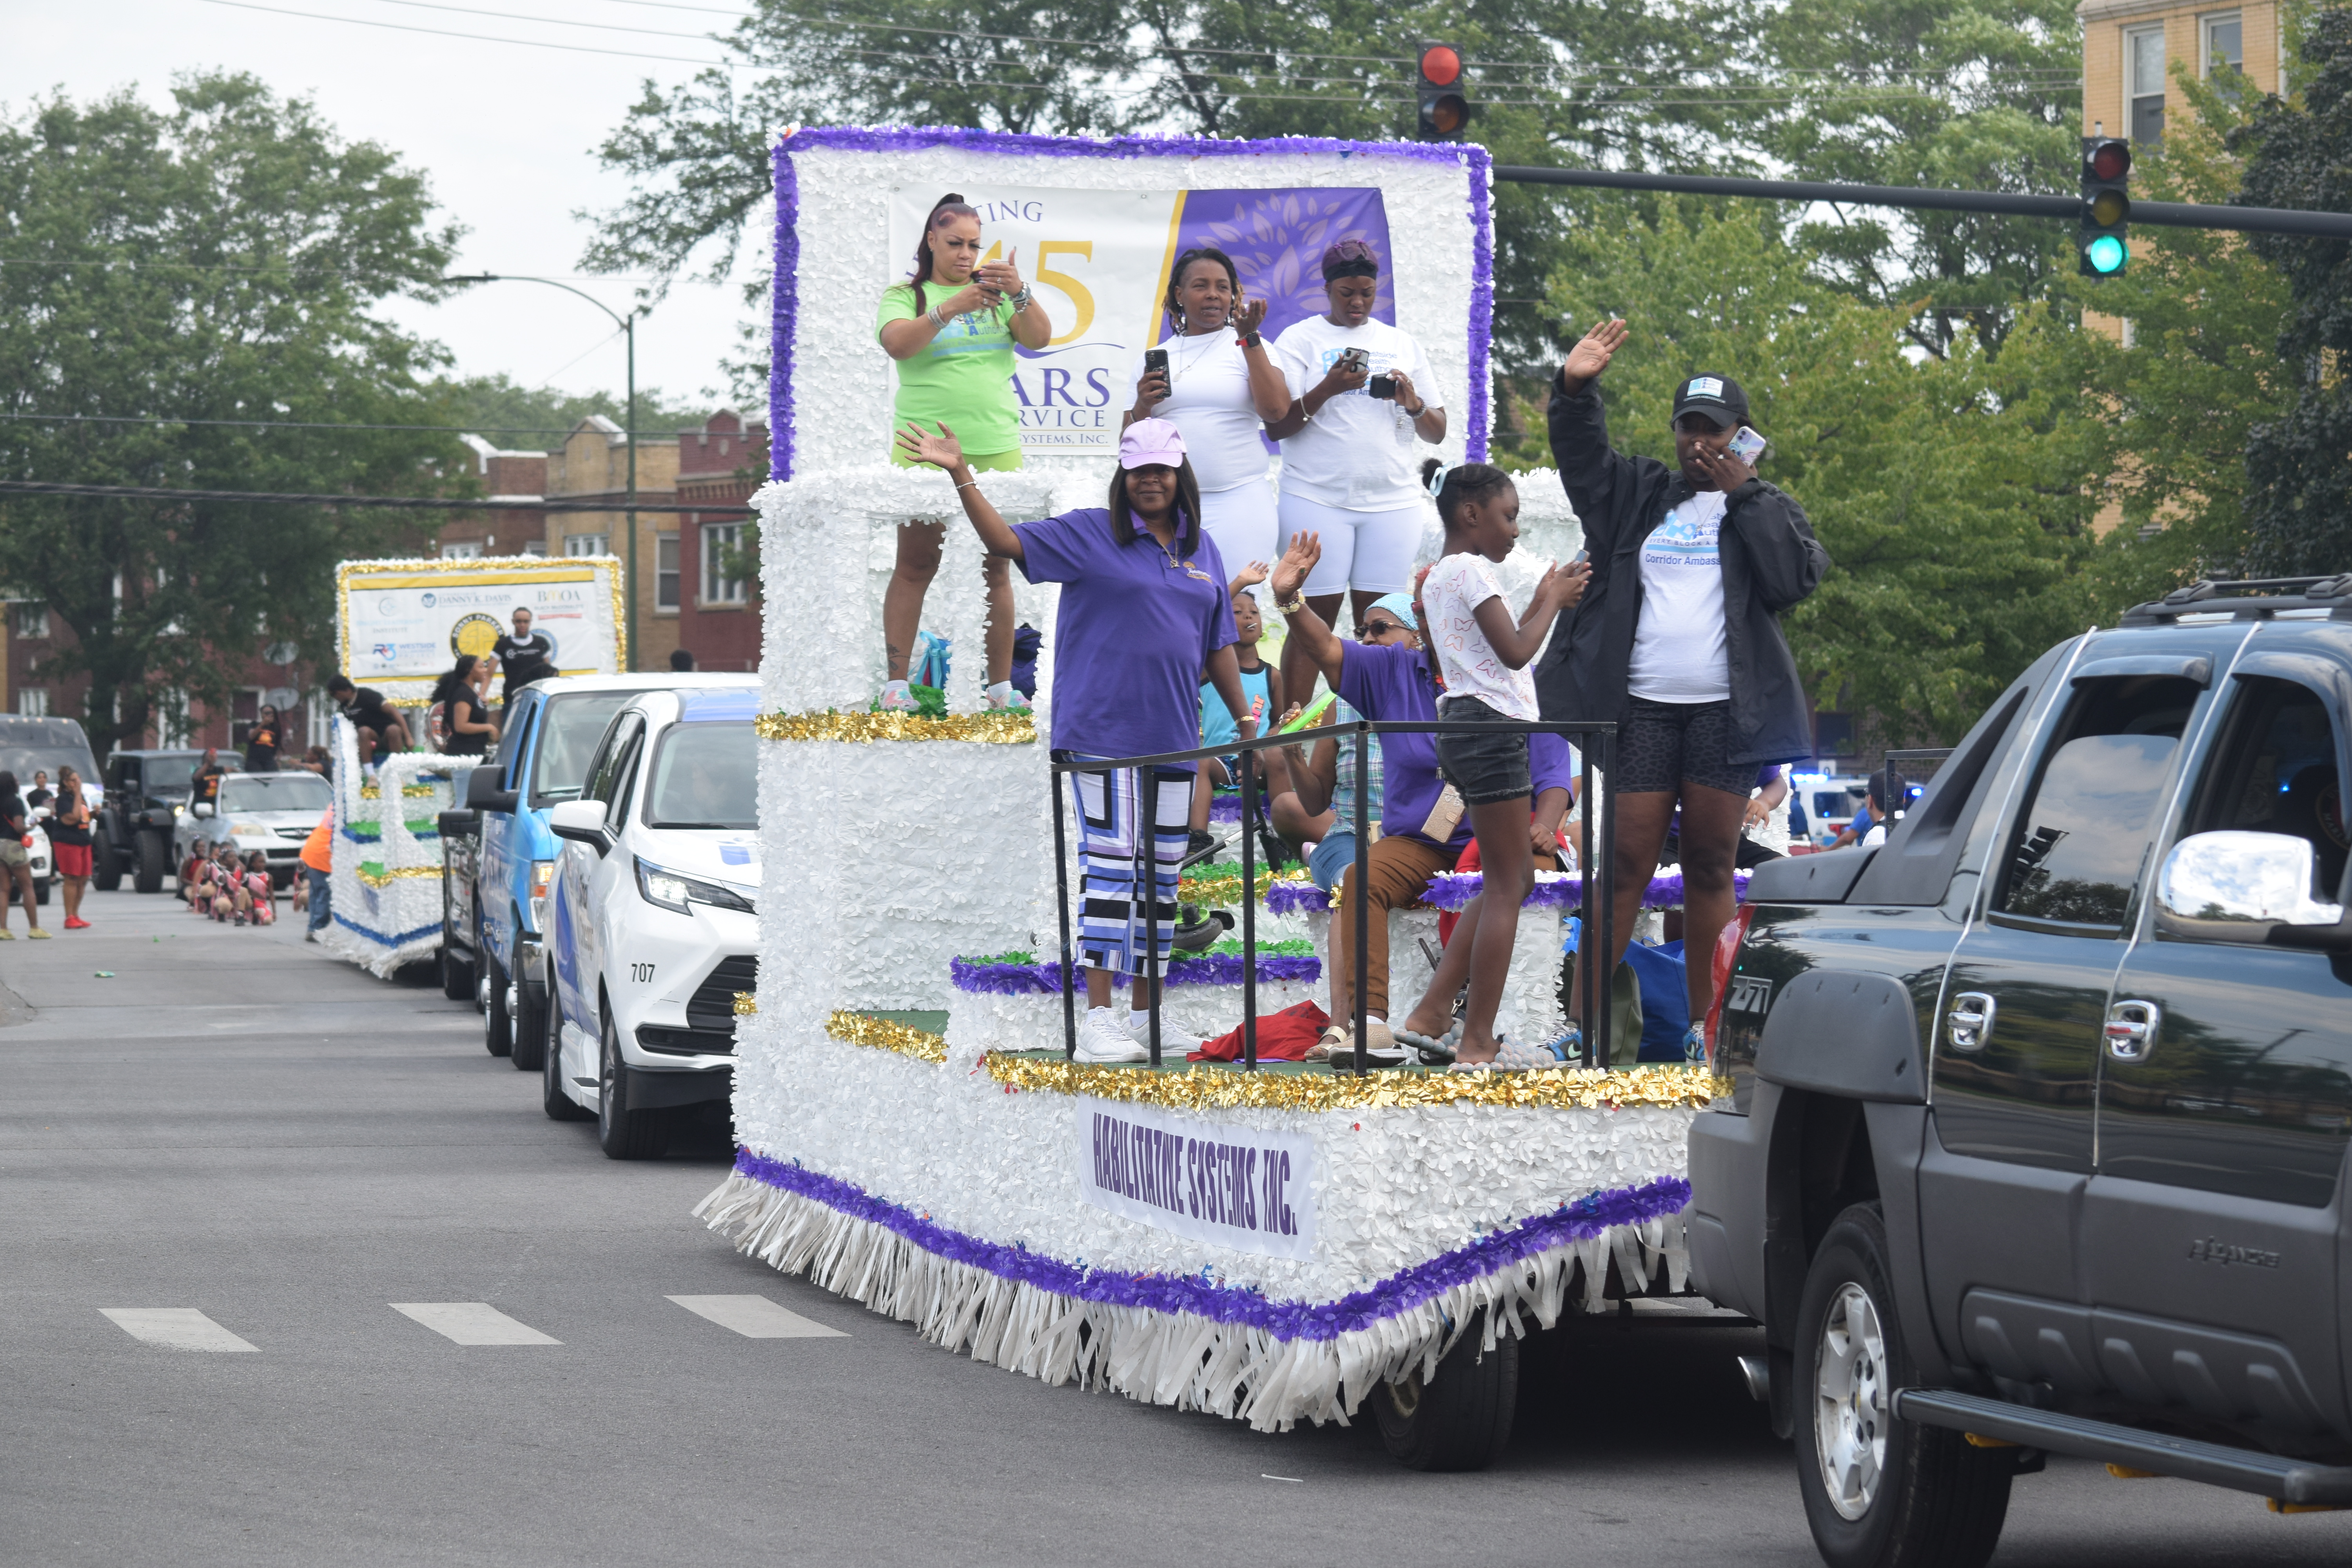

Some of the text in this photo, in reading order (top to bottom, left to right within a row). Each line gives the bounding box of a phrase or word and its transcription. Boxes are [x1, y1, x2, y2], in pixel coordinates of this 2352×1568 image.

[1008, 368, 1110, 407] ARS
[1018, 409, 1105, 427] RVICE
[1646, 554, 1721, 565] Corridor Ambass
[452, 614, 504, 638] SONNY PARKER
[631, 963, 655, 983] 707
[1729, 975, 1773, 1014] Z71
[1187, 1138, 1256, 1230] SYSTEMS
[1263, 1149, 1298, 1236] INC.
